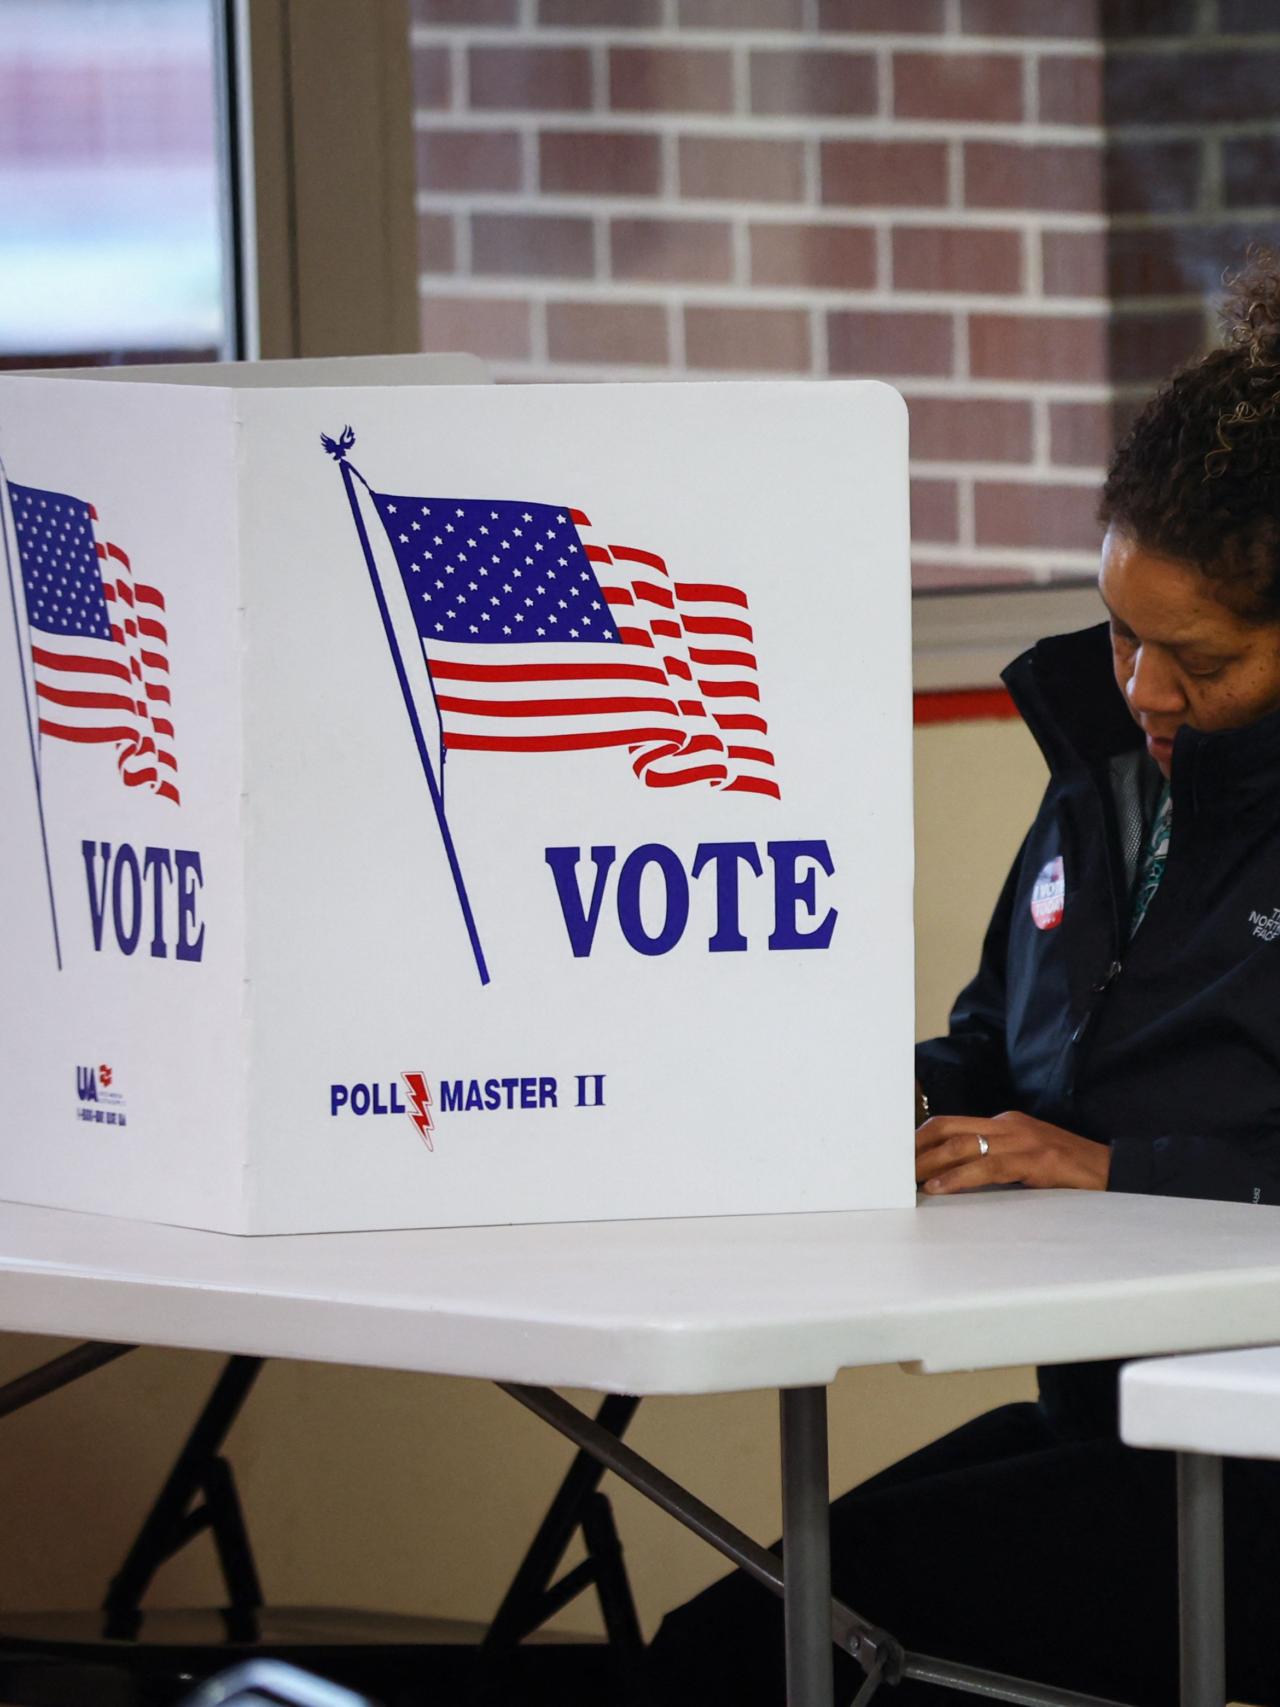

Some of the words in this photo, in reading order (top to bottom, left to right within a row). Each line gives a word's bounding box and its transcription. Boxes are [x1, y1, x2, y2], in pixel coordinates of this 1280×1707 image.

[81, 840, 205, 962] VOTE
[545, 840, 838, 957] VOTE
[1253, 926, 1279, 941] FACE
[77, 1065, 99, 1102] UA
[331, 1083, 406, 1116] POLL
[440, 1077, 558, 1112] MASTER
[574, 1074, 606, 1107] II
